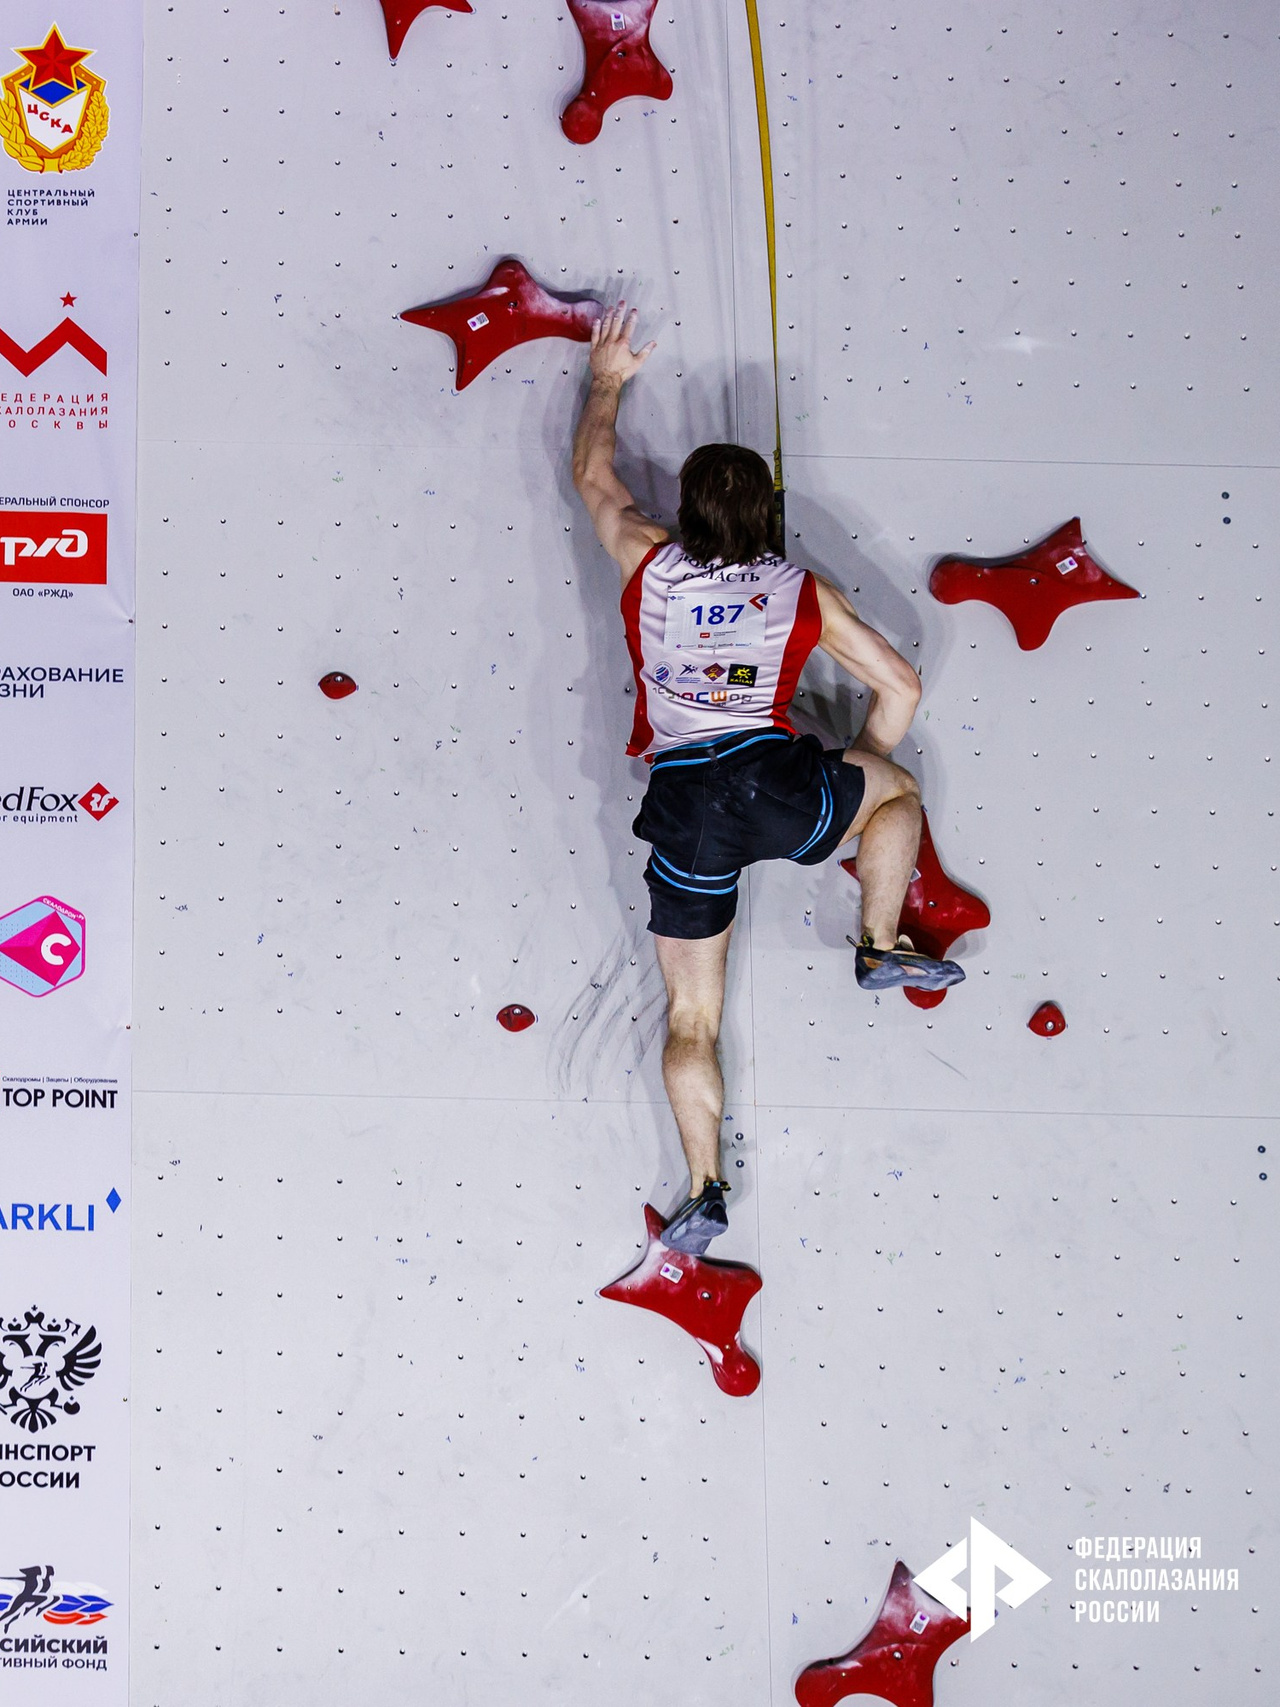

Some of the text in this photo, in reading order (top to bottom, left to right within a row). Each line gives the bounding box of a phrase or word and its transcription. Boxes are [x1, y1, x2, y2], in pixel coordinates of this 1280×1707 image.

[27, 104, 73, 133] ЦСКА
[8, 189, 94, 197] ЦЕНТРАЛЬНЫЙ
[8, 198, 88, 206] СПОРТИВНЫЙ
[60, 498, 109, 508] СПОНСОР
[13, 588, 73, 599] ОАО «РЖД»
[691, 604, 745, 626] 187
[13, 814, 77, 824] equipment
[3, 1088, 118, 1108] TOP POINT
[62, 1659, 107, 1671] ФОНД
